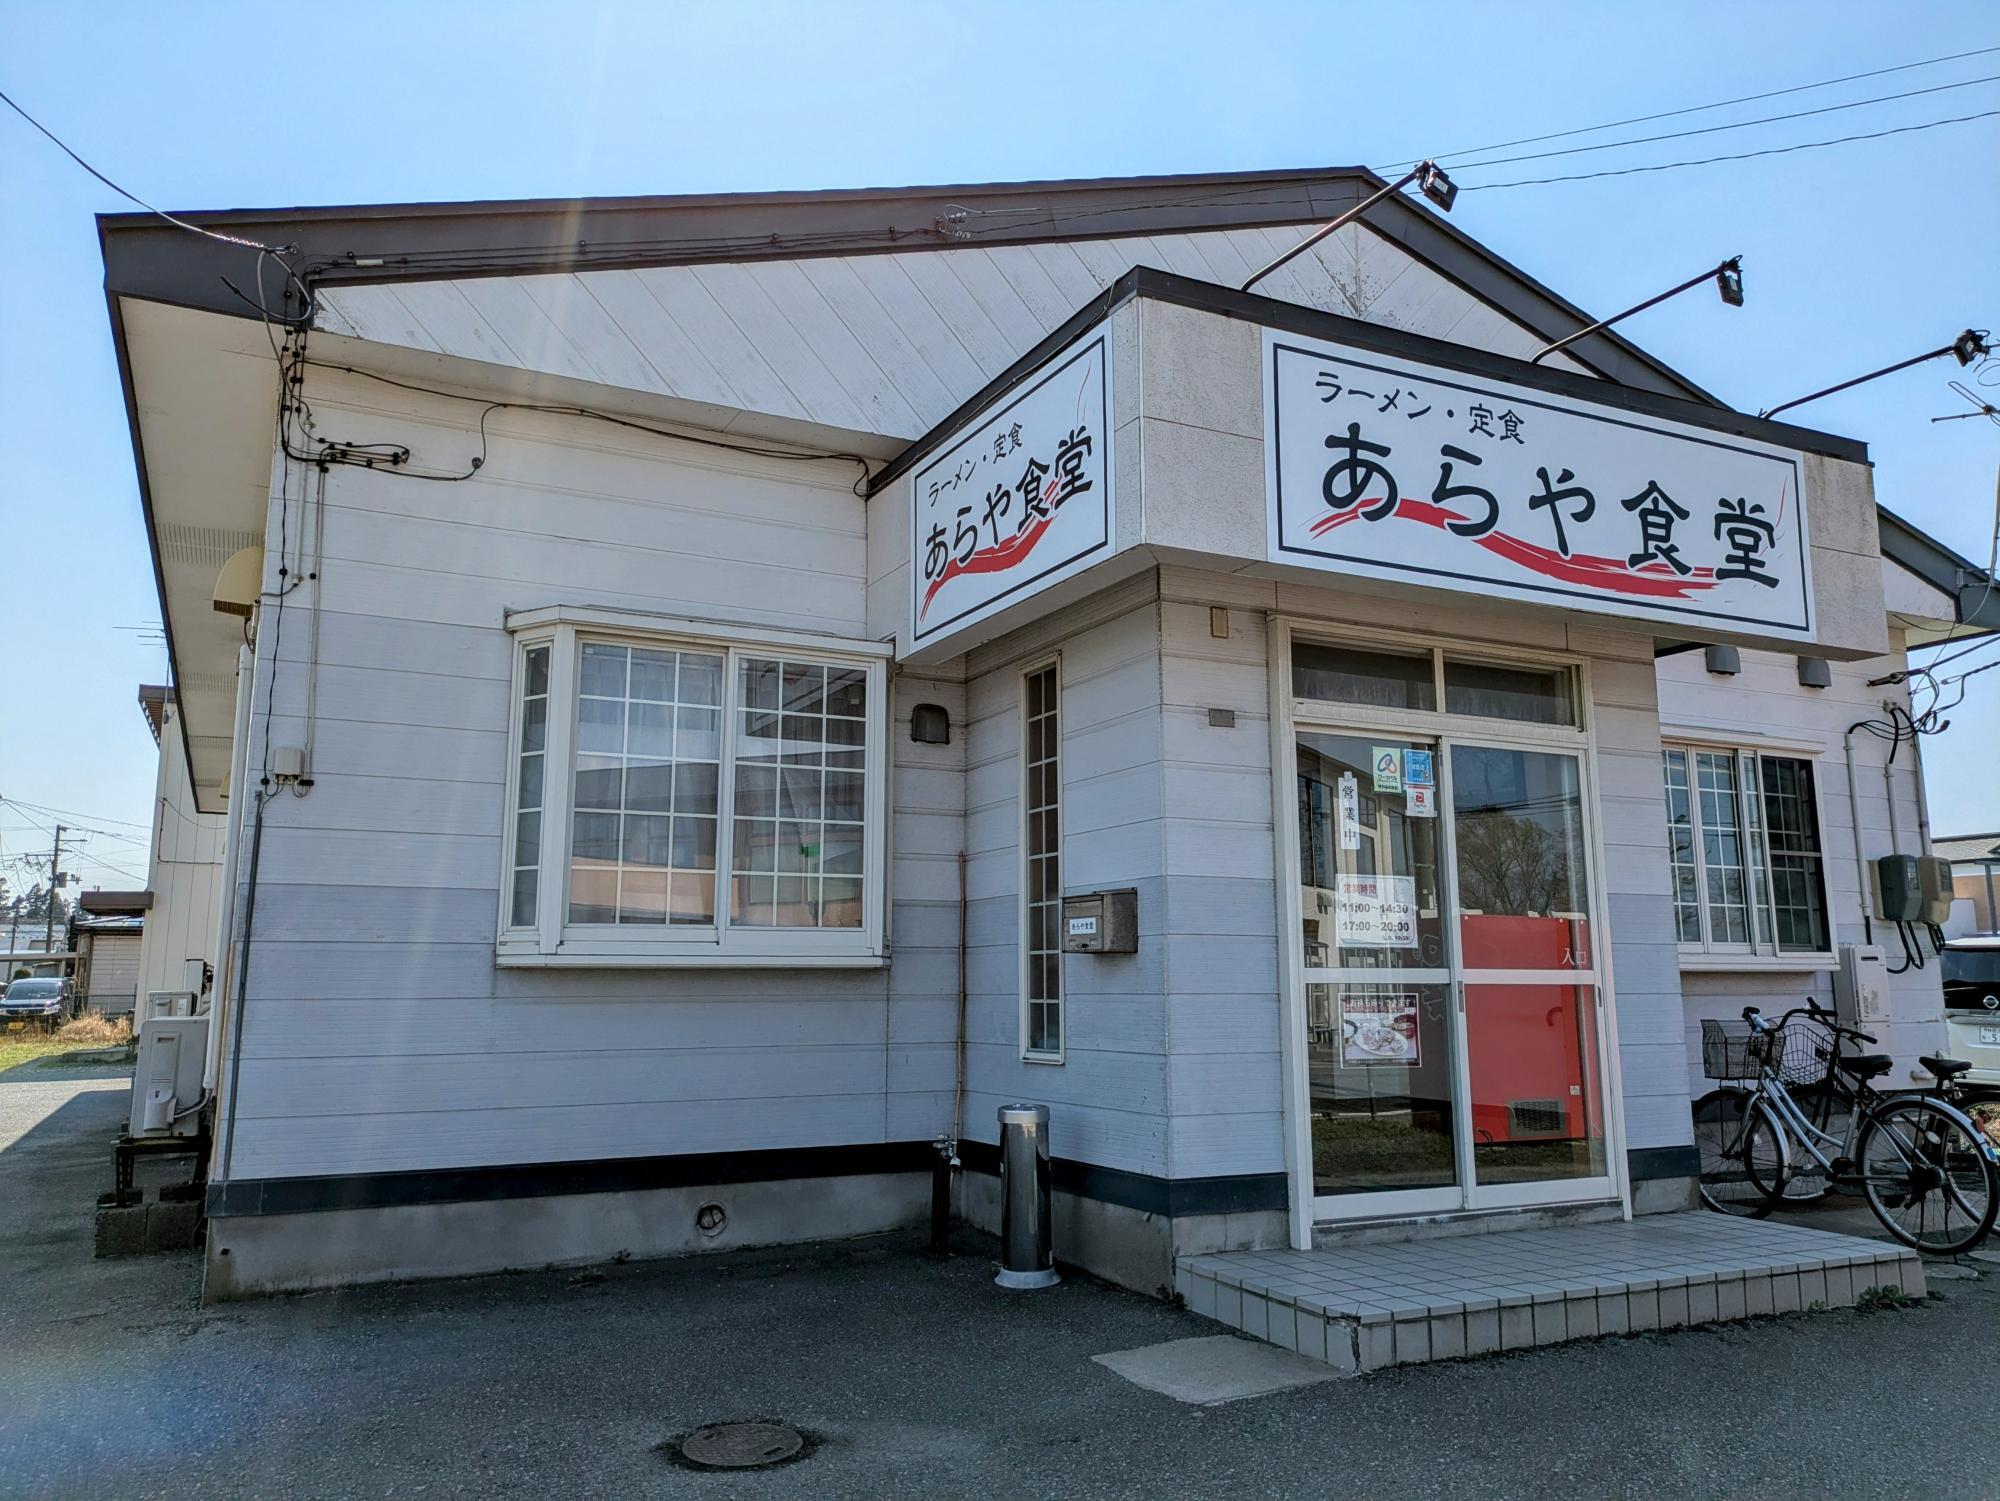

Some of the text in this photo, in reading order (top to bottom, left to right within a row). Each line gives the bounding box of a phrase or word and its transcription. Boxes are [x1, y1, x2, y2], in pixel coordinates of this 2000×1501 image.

[1315, 371, 1525, 445] ラーメン・定食
[928, 422, 1023, 507] ラーメン・定食
[925, 425, 1093, 581] あらや食堂
[1322, 422, 1780, 588] あらや食堂
[1342, 785, 1356, 843] 営業中
[1343, 884, 1377, 894] 営業時間
[1561, 947, 1587, 966] 入口
